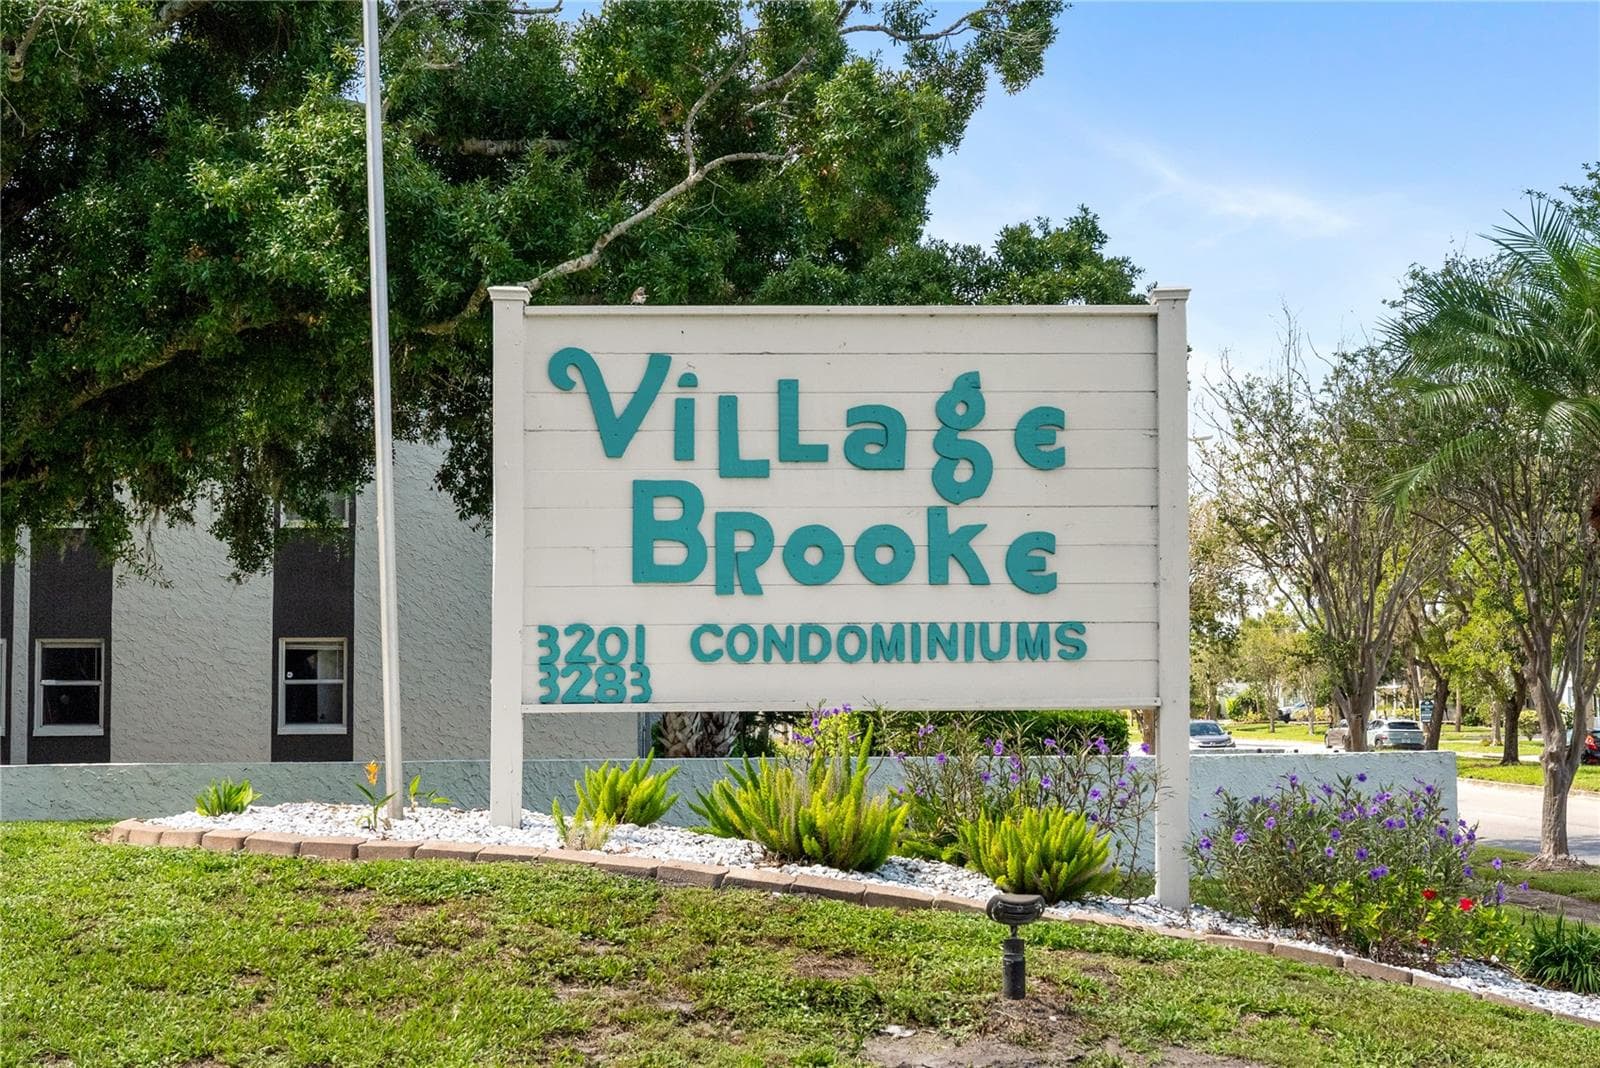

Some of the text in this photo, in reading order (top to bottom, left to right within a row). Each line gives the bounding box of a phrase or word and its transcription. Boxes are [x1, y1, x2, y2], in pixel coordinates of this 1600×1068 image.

[537, 623, 646, 664] 3201
[690, 622, 1088, 663] CONDOMINIUMS
[538, 662, 653, 704] 3283
